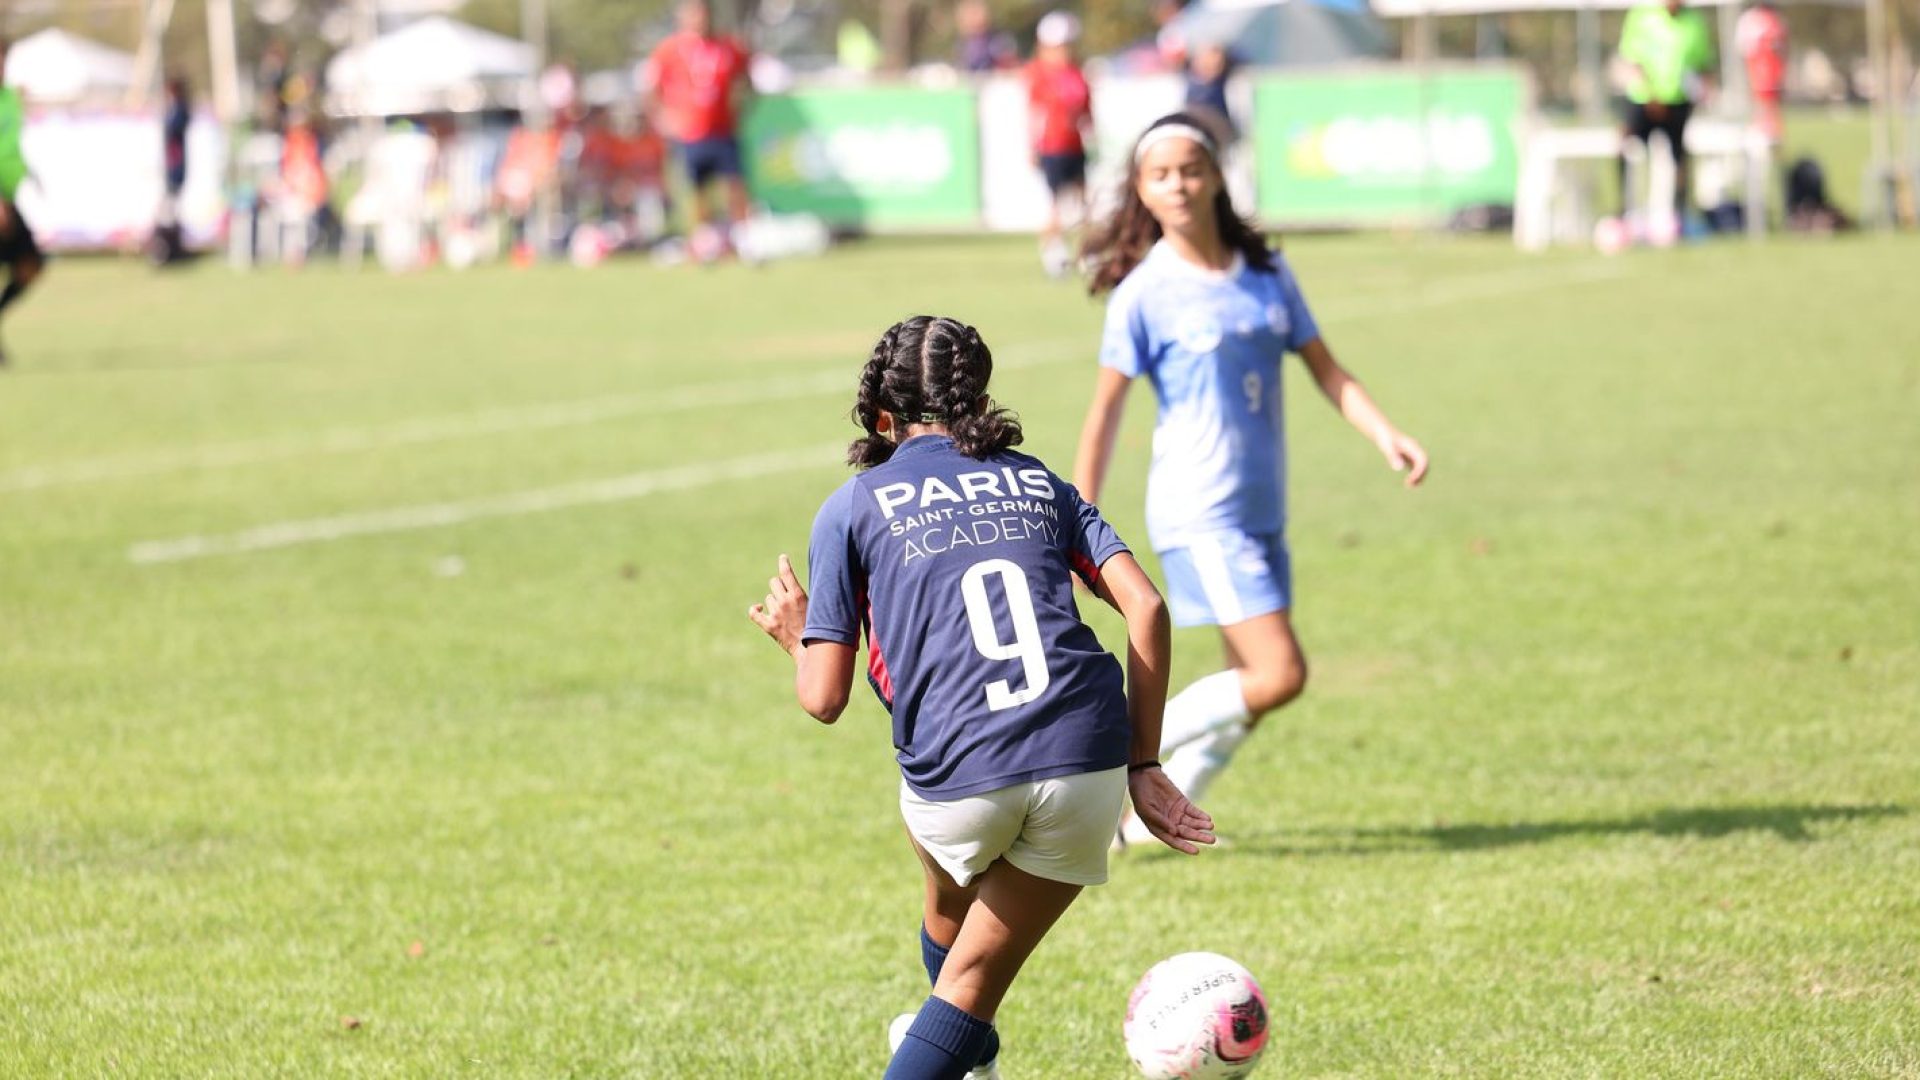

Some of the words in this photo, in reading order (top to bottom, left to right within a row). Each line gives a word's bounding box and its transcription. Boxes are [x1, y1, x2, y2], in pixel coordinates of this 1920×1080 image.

[1242, 370, 1263, 412] 9
[874, 466, 1056, 520] PARIS
[890, 500, 1059, 537] SAINT-GERMAIN
[903, 517, 1059, 567] ACADEMY
[961, 558, 1050, 712] 9
